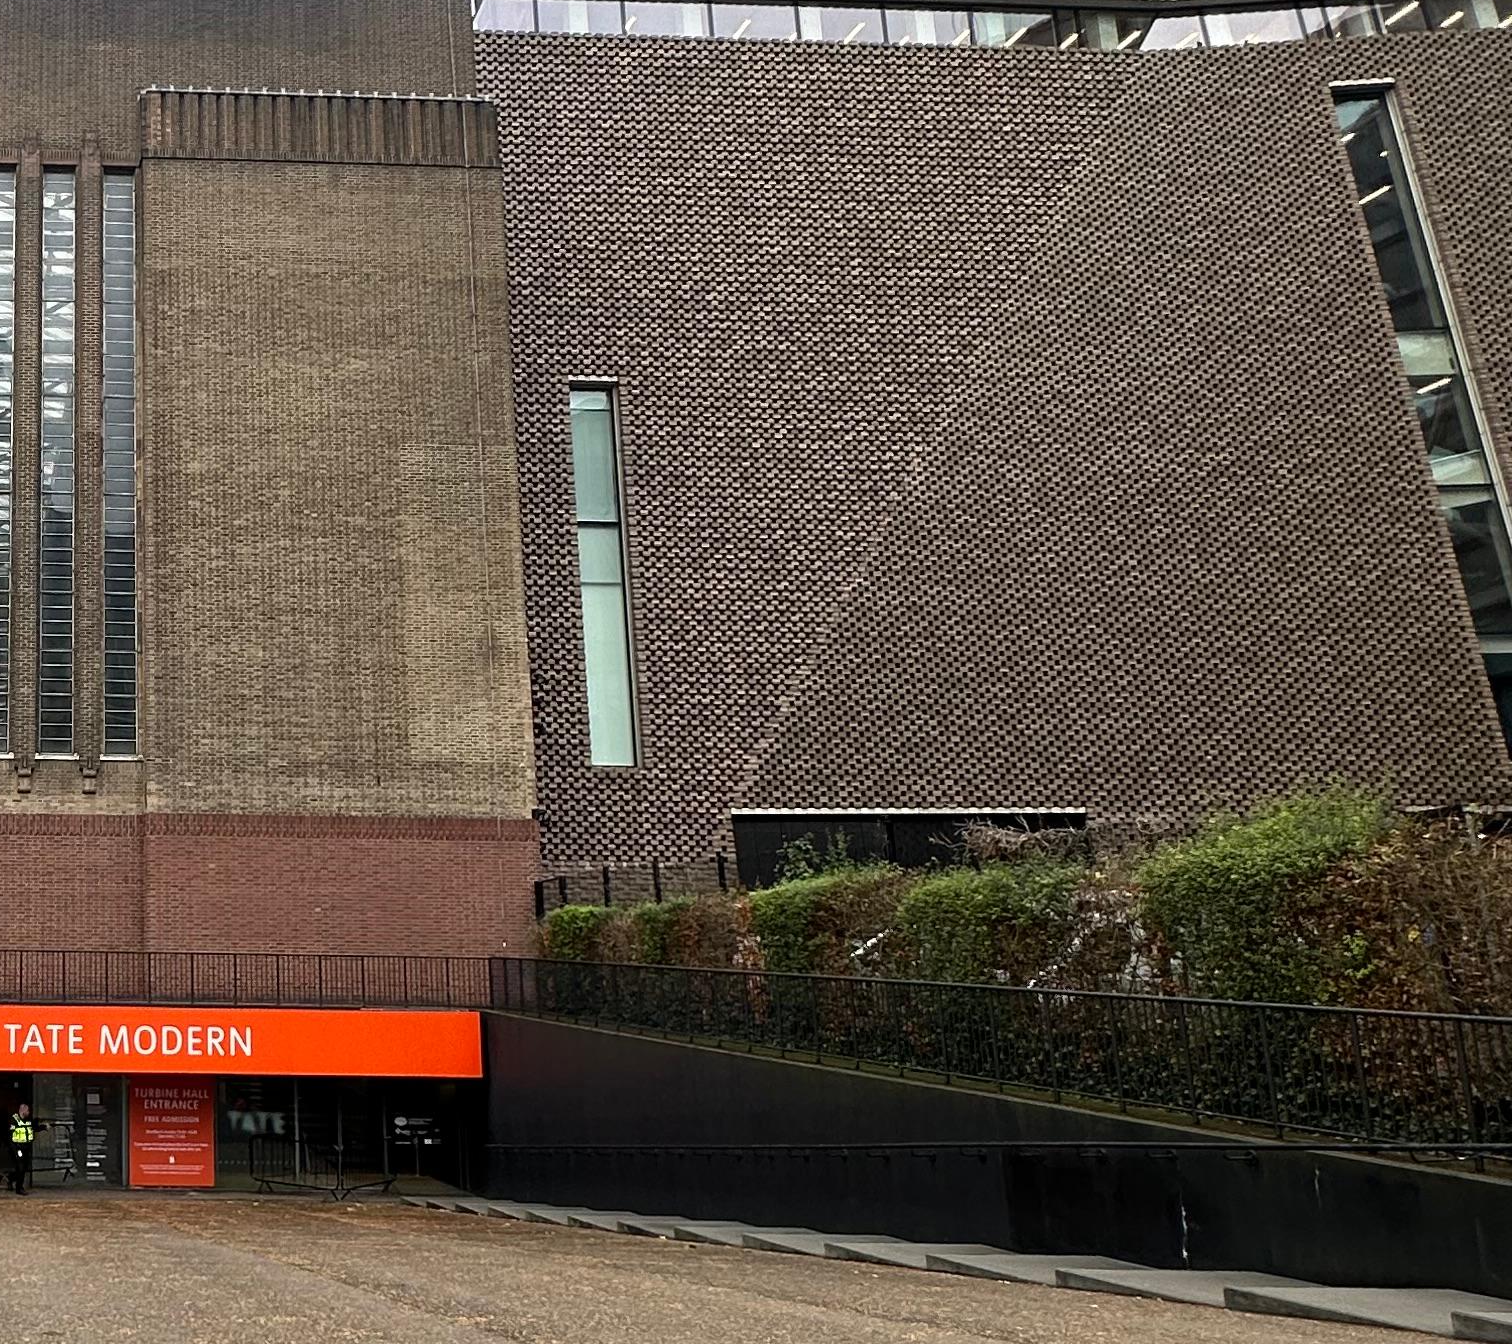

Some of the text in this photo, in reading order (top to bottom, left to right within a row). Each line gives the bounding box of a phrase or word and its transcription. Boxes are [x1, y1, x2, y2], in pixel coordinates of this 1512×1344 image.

[3, 1023, 84, 1055] TATE
[99, 1024, 252, 1057] MODERN
[134, 1088, 209, 1099] TURBINE HALL
[144, 1099, 199, 1110] ENTRANCE
